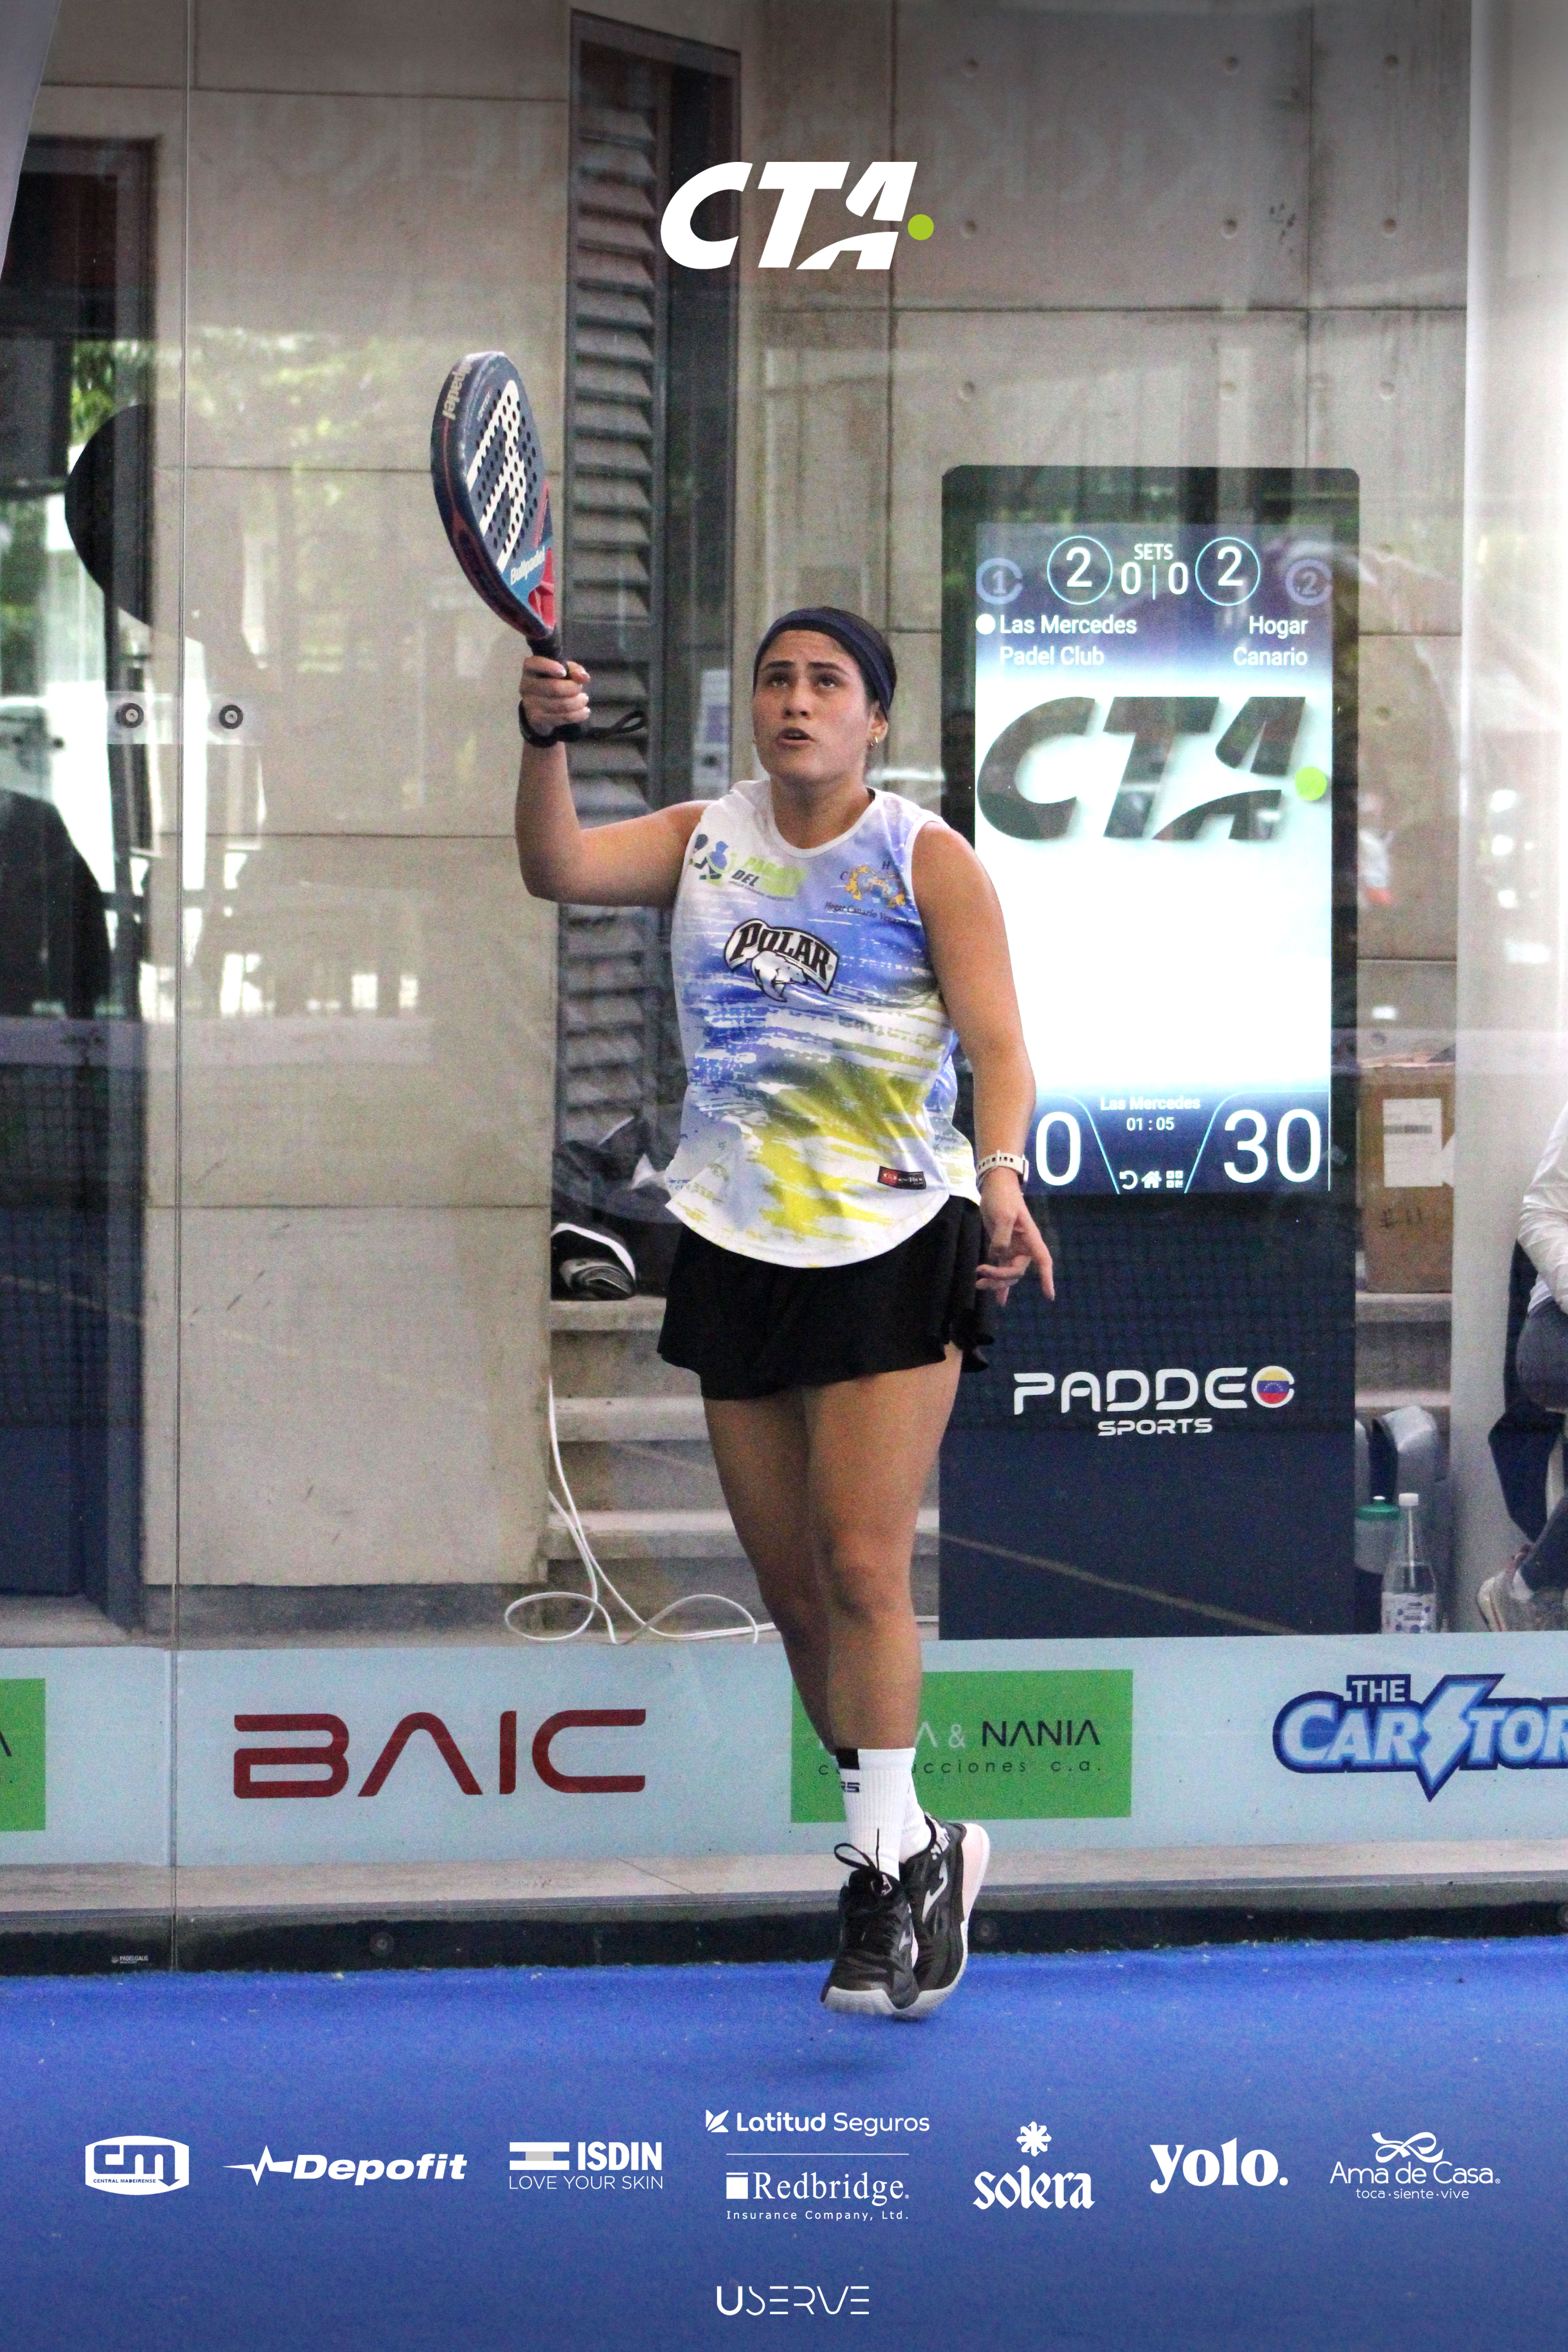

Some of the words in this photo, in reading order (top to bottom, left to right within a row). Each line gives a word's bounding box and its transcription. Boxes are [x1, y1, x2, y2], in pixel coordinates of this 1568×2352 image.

[1134, 543, 1173, 560] SETS
[1065, 547, 1093, 588] 2
[1121, 562, 1142, 595] 0
[1168, 562, 1189, 595] 0
[1217, 547, 1243, 587] 2
[1000, 616, 1035, 634] Las
[1041, 614, 1137, 634] Mercedes
[1249, 617, 1308, 639] Hogar
[1000, 646, 1054, 666] Padel
[1061, 646, 1104, 666] Club
[1233, 647, 1308, 666] Canario
[977, 697, 1307, 840] CTA
[731, 869, 760, 887] DEL
[731, 922, 830, 980] POLAR
[1100, 1097, 1126, 1111] Las
[1130, 1096, 1200, 1110] Mercedes
[1035, 1111, 1081, 1187] 0
[1223, 1109, 1321, 1184] 30
[1098, 1418, 1214, 1436] SPORTS
[1352, 1680, 1405, 1702] THE
[982, 1720, 1101, 1748] NANIA
[234, 1709, 646, 1799] BAIC
[1051, 1759, 1102, 1772] c.a.
